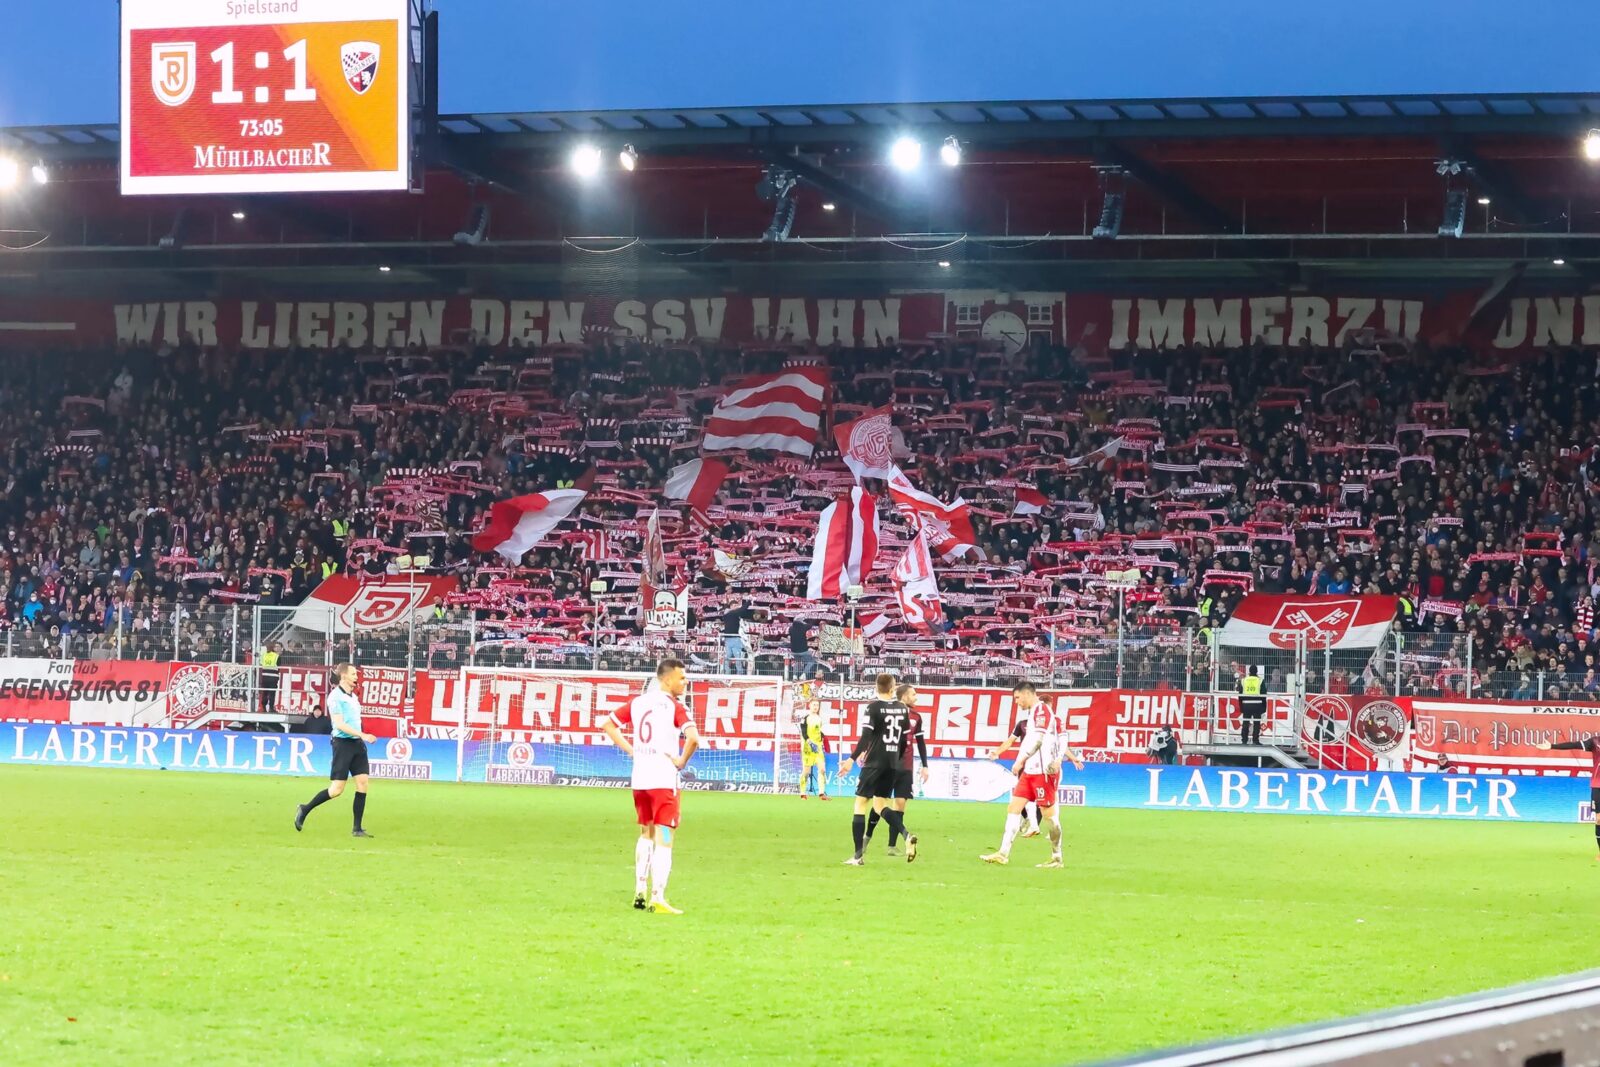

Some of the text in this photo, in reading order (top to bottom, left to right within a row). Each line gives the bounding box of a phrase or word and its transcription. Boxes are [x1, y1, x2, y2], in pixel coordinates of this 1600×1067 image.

[226, 0, 298, 18] Spielstand
[239, 118, 283, 137] 73:05
[193, 142, 332, 168] MÜHLBACHER
[114, 301, 218, 347] WIR
[240, 300, 446, 348] LIEBEN
[470, 298, 585, 347] DEN
[613, 297, 727, 343] SSV
[1109, 296, 1423, 350] IMMERZU
[644, 609, 686, 628] ULTRAS
[48, 660, 99, 674] Fanclub
[362, 668, 405, 682] SSV JAHN
[134, 680, 162, 703] 81
[361, 680, 404, 706] 1889
[817, 684, 841, 699] RED
[360, 704, 400, 717] REGENSBURG
[431, 677, 630, 728] ULTRAS
[1116, 694, 1186, 726] JAHN
[1532, 706, 1600, 716] FANCLU
[639, 710, 653, 744] 6
[883, 715, 905, 744] 35
[1440, 720, 1480, 746] Die
[1489, 719, 1562, 751] Power
[11, 725, 317, 774] LABERTALER
[369, 763, 428, 778] LABERTALER
[490, 768, 550, 784] LABERTALER
[570, 778, 629, 788] Dallmeier
[1036, 787, 1045, 799] 19
[1144, 768, 1520, 818] LABERTALER
